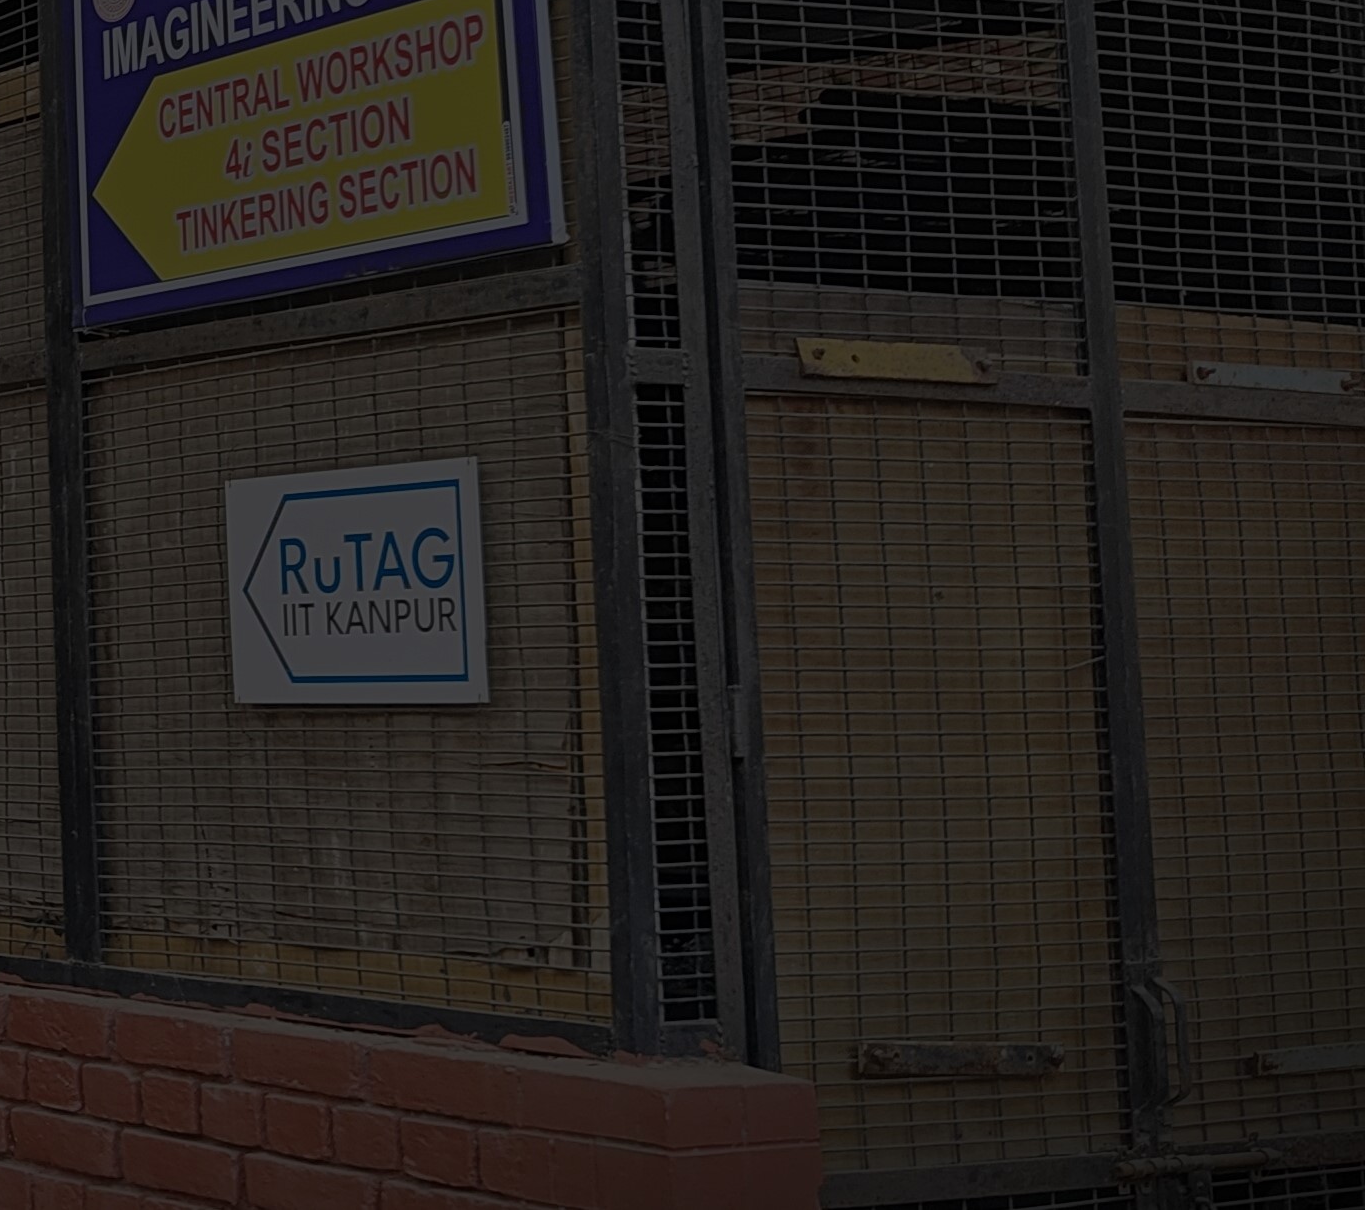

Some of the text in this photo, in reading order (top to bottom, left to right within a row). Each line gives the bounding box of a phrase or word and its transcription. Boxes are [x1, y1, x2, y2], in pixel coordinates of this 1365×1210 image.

[158, 13, 485, 138] CENTRAL WORKSHOP
[225, 97, 411, 180] 4i SECTION
[176, 181, 329, 252] TINKERING
[338, 148, 477, 220] SECTION
[279, 527, 455, 595] RuTAG
[283, 597, 457, 637] IIT KANPUR
